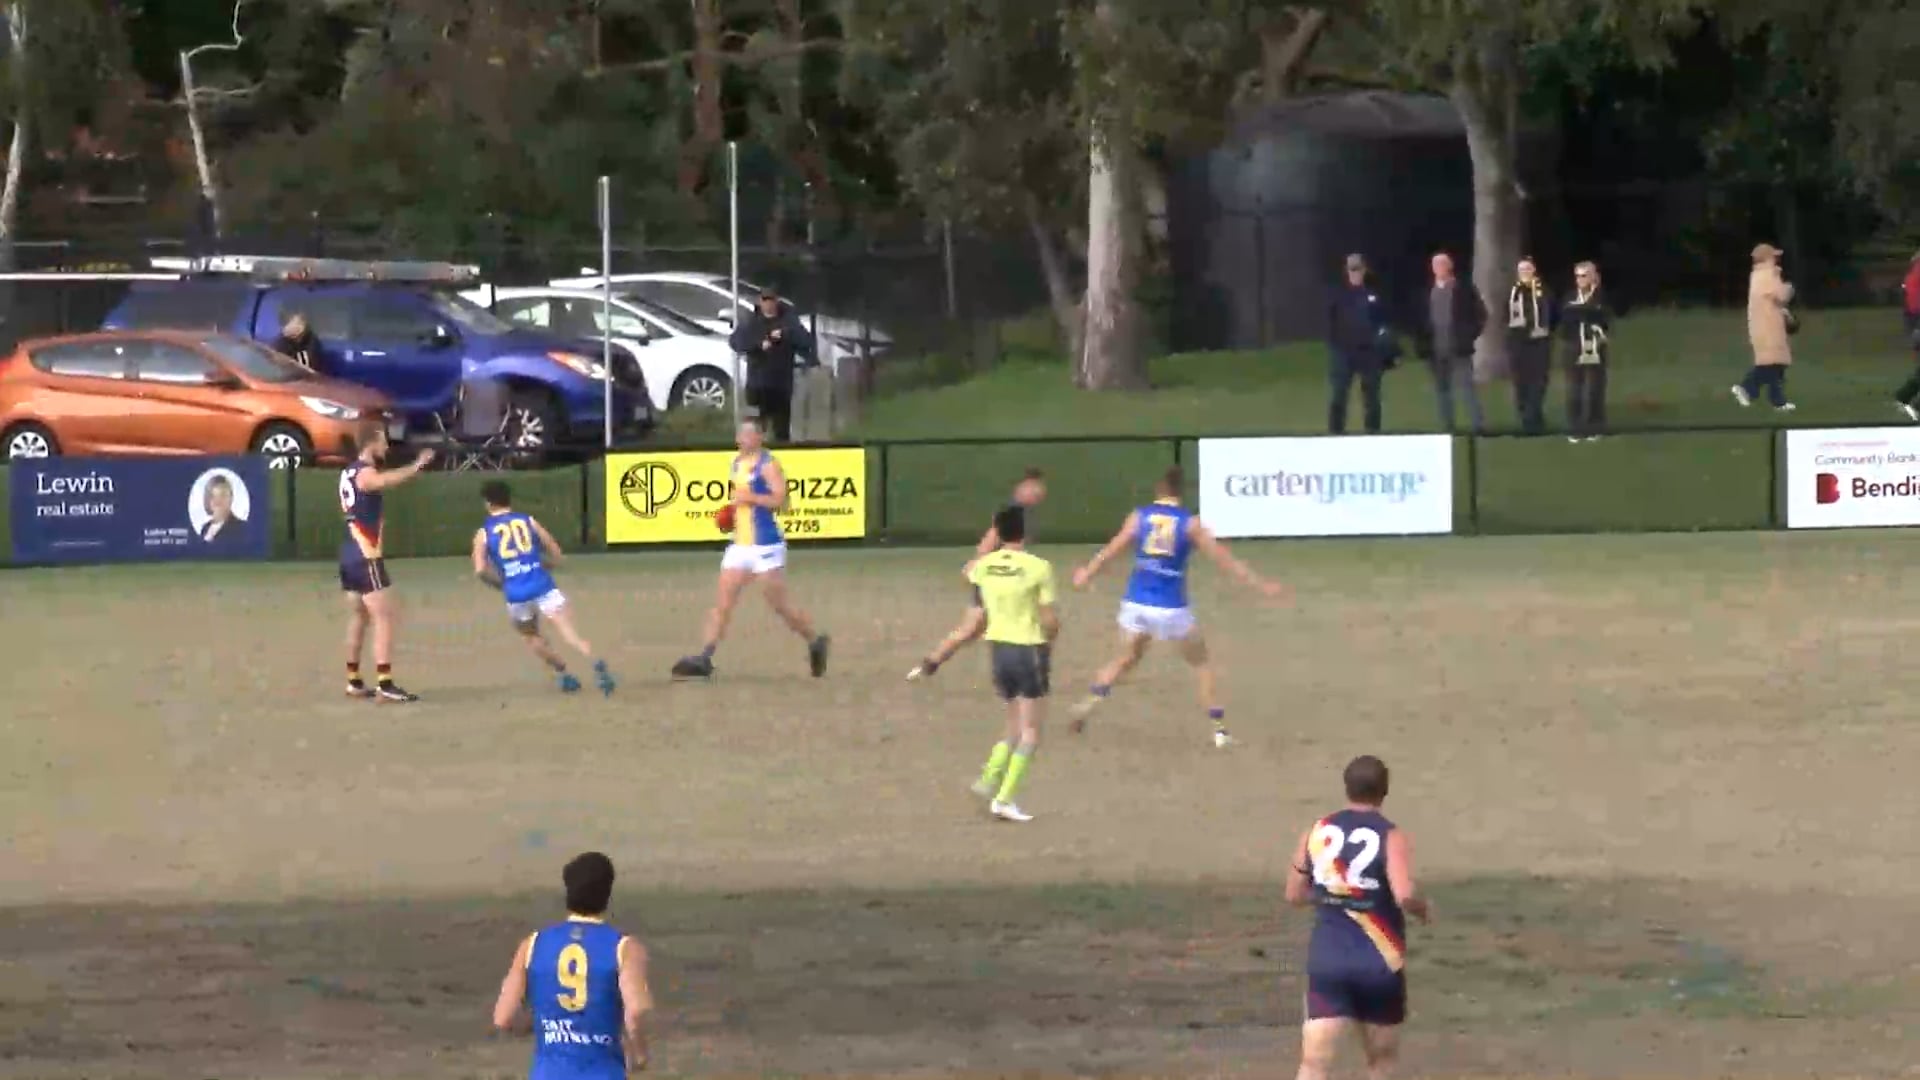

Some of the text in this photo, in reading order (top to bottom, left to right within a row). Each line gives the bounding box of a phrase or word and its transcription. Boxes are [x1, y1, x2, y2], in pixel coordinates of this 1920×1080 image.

[36, 471, 115, 495] Lewin
[786, 477, 858, 499] PIZZA
[1852, 475, 1920, 500] Bendi
[36, 501, 114, 516] real estate
[493, 518, 533, 559] 20
[556, 943, 588, 1012] 9
